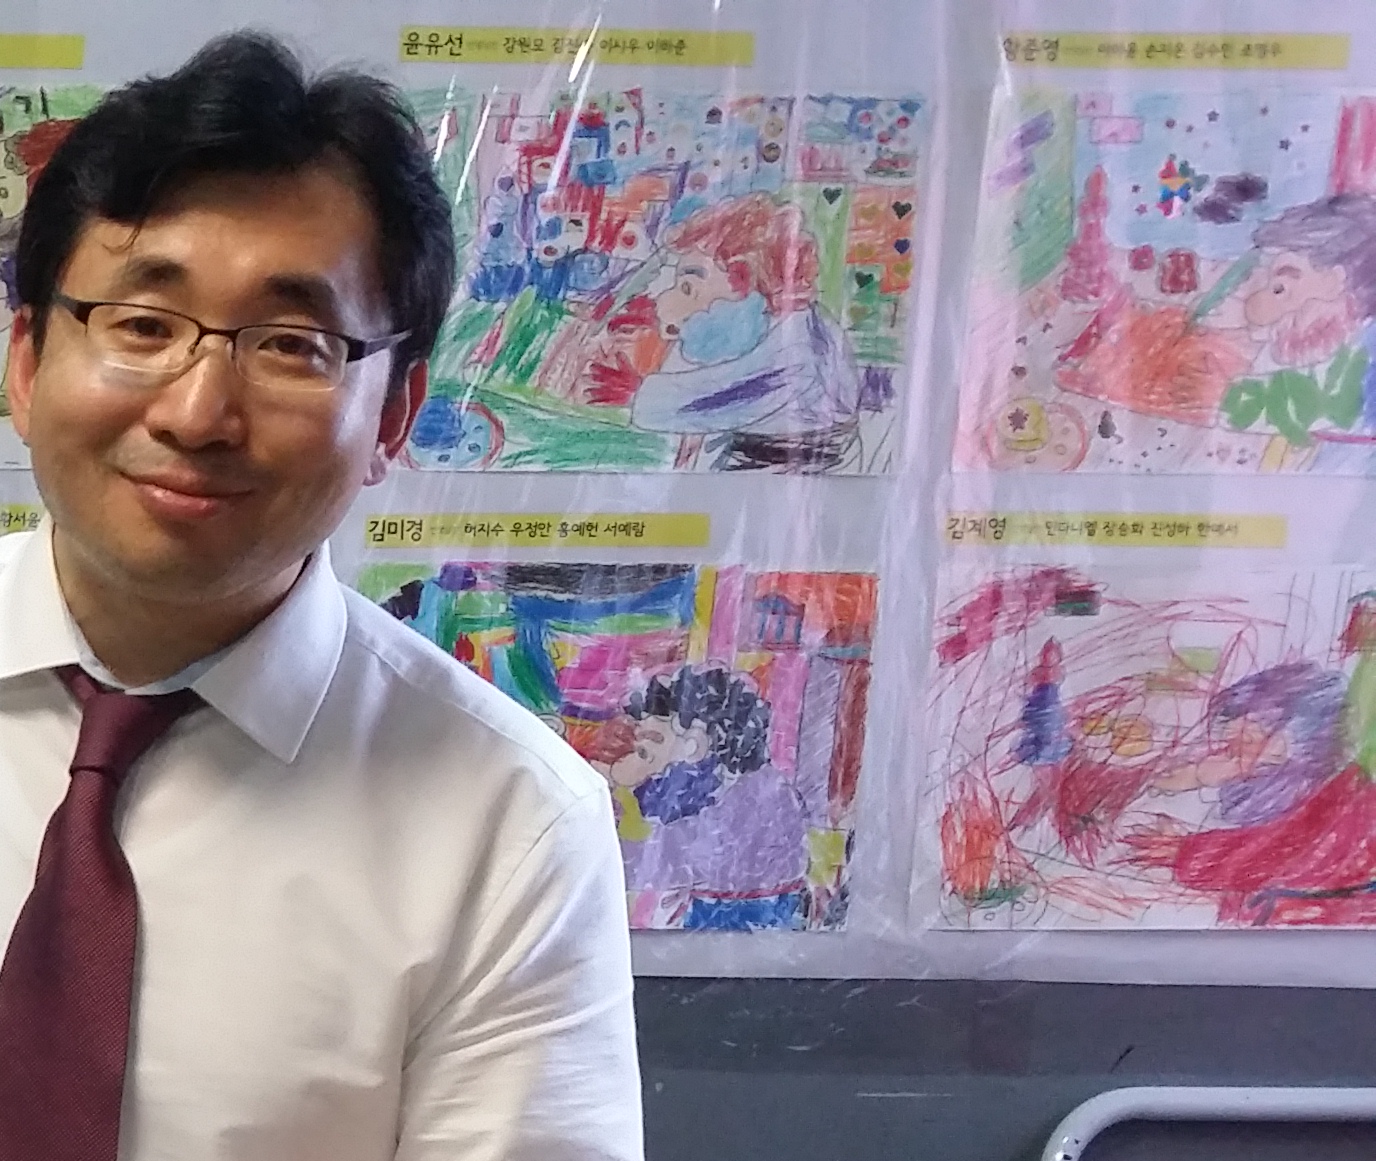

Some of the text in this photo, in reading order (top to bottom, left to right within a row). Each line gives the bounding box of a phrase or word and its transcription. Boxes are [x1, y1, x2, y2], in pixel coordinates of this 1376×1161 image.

[403, 32, 464, 56] 윤유선
[368, 518, 423, 543] 김미경
[509, 521, 552, 539] 우정안
